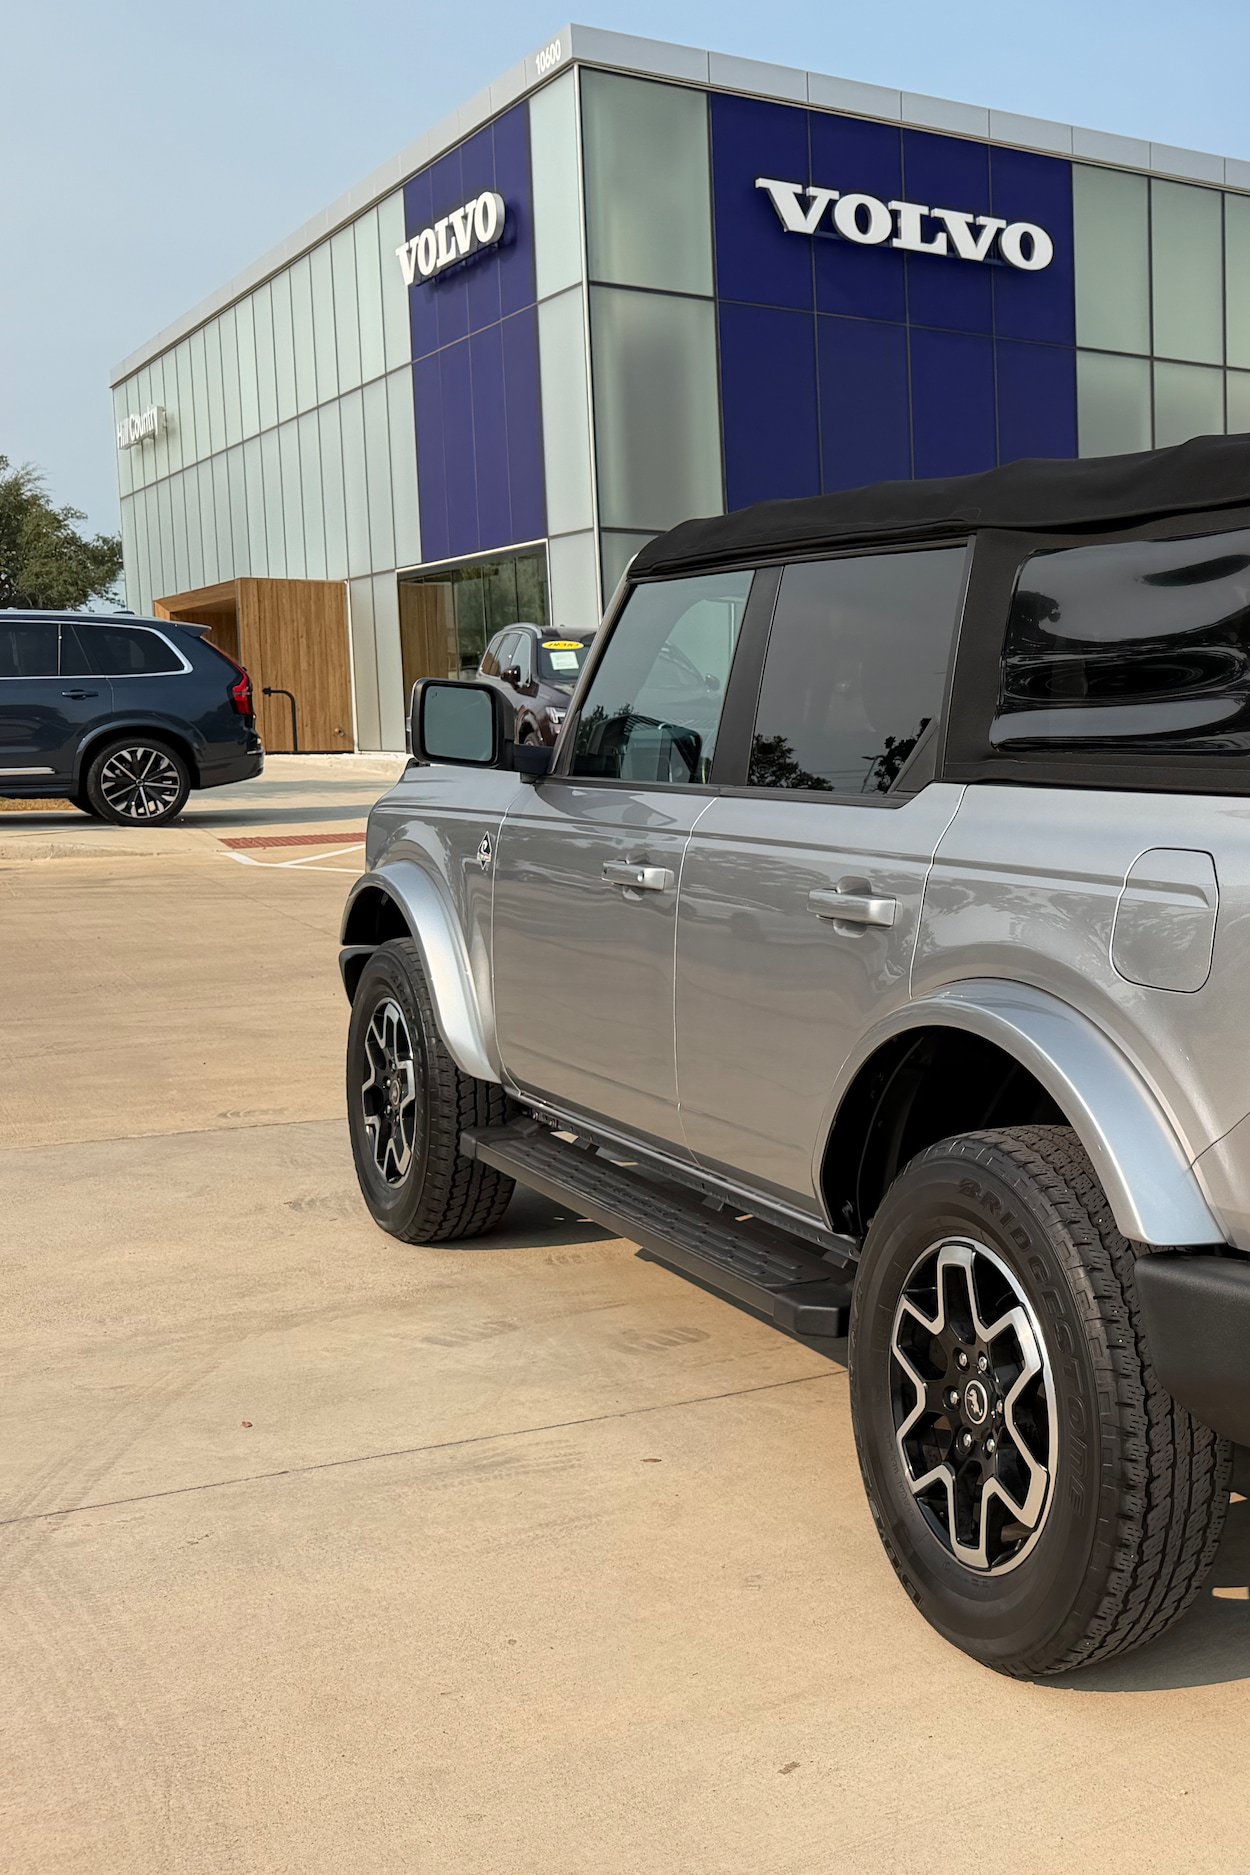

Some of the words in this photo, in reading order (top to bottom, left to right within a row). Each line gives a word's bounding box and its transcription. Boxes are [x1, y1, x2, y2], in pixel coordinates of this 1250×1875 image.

[535, 39, 561, 75] 10600
[395, 191, 499, 286] VOLVO
[755, 177, 1054, 271] VOLVO
[129, 405, 158, 442] Country
[958, 1177, 1088, 1516] BRIDGESTONE
